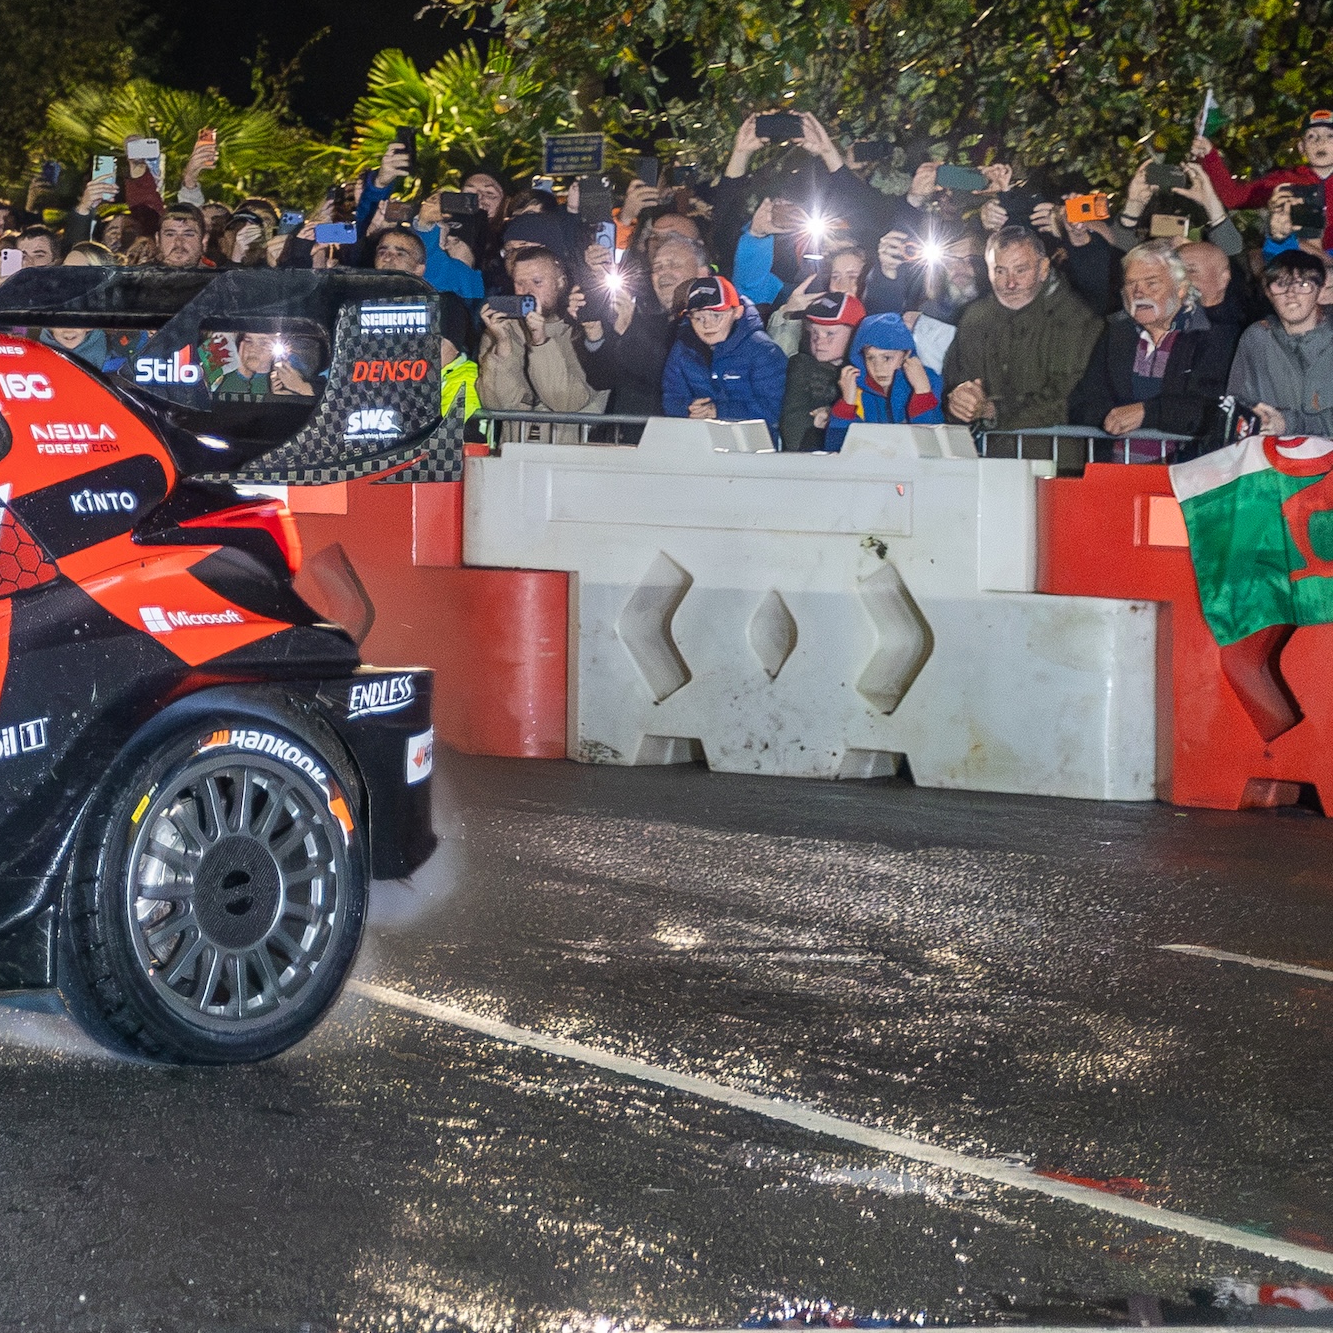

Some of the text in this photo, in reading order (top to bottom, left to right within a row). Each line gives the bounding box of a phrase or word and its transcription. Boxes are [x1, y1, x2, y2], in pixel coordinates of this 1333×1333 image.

[135, 344, 199, 383] Stilo
[351, 359, 428, 383] DENSO
[347, 409, 394, 433] SWS
[167, 609, 244, 626] Microsoft
[349, 674, 413, 711] ENDLESS
